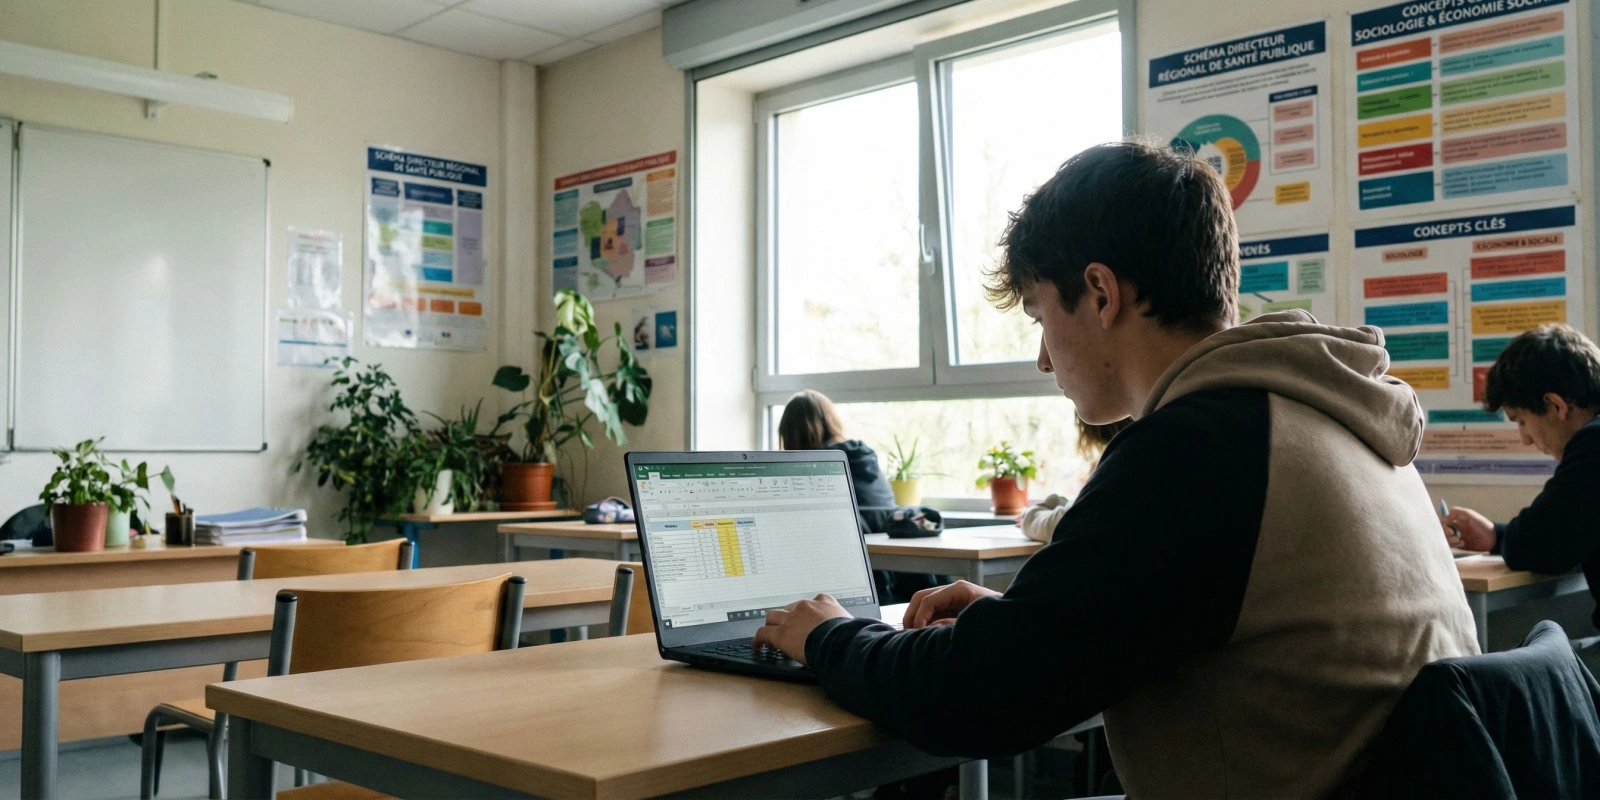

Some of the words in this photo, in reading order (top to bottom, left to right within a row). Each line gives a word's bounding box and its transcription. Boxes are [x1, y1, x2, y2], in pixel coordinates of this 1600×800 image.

[1355, 16, 1425, 42] SOCIOLOGIE
[1427, 15, 1436, 27] &
[1438, 0, 1504, 26] ÉCONOMIE
[1158, 61, 1207, 82] RÉGIONAL
[1208, 59, 1222, 72] DE
[1224, 51, 1258, 69] SANTÉ
[1260, 40, 1315, 61] PUBLIQUE
[1183, 46, 1226, 65] SCHÉMA
[1227, 34, 1285, 56] DIRECTEUR
[1474, 217, 1506, 231] CLÉS
